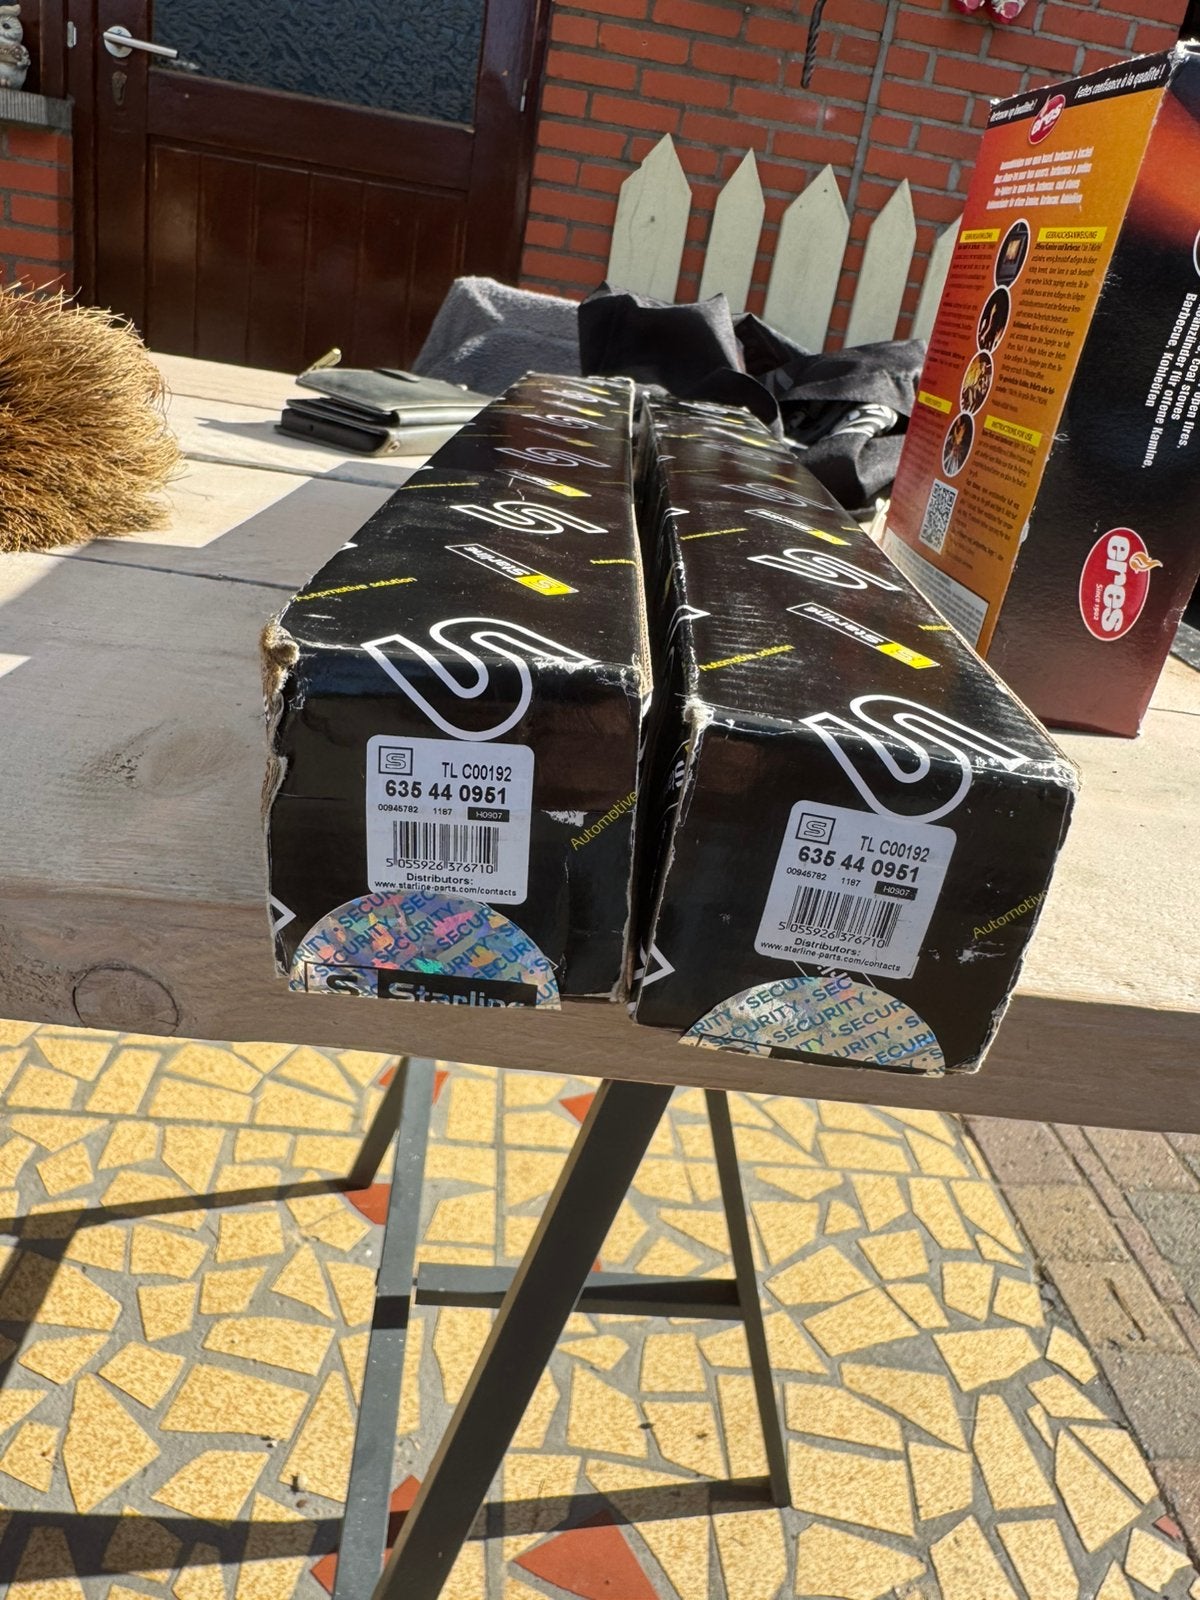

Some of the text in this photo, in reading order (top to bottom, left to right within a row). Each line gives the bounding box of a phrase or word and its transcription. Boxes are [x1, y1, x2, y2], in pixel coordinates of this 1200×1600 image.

[1031, 104, 1062, 136] eres
[1145, 293, 1198, 407] Barbecue, Kohleöfen
[1168, 370, 1182, 387] für
[1171, 358, 1200, 420] coal stoves
[1155, 389, 1173, 424] offene
[1141, 427, 1163, 468] Kamine,
[1177, 421, 1195, 448] fires,
[1101, 535, 1131, 632] eres
[804, 606, 884, 644] Starline
[441, 762, 513, 782] TL C00192
[385, 779, 507, 805] 635 44 0951
[433, 807, 453, 815] 1187
[475, 810, 503, 819] H0907
[570, 791, 638, 851] Automotive
[798, 845, 920, 883] 635 44 0951
[861, 836, 930, 863] TL C00192
[386, 858, 494, 874] 5 055926 376710
[406, 872, 474, 886] Distributors:
[375, 881, 517, 897] www.starline-parts.com/contacts
[841, 877, 862, 887] 1187
[883, 885, 911, 897] H0907
[376, 902, 455, 964] SECURITY
[789, 923, 836, 940] 055926
[839, 932, 886, 948] 376710
[794, 937, 862, 957] Distributors:
[760, 941, 901, 972] www.starline-parts.com/contacts
[773, 992, 865, 1043] SECURITY
